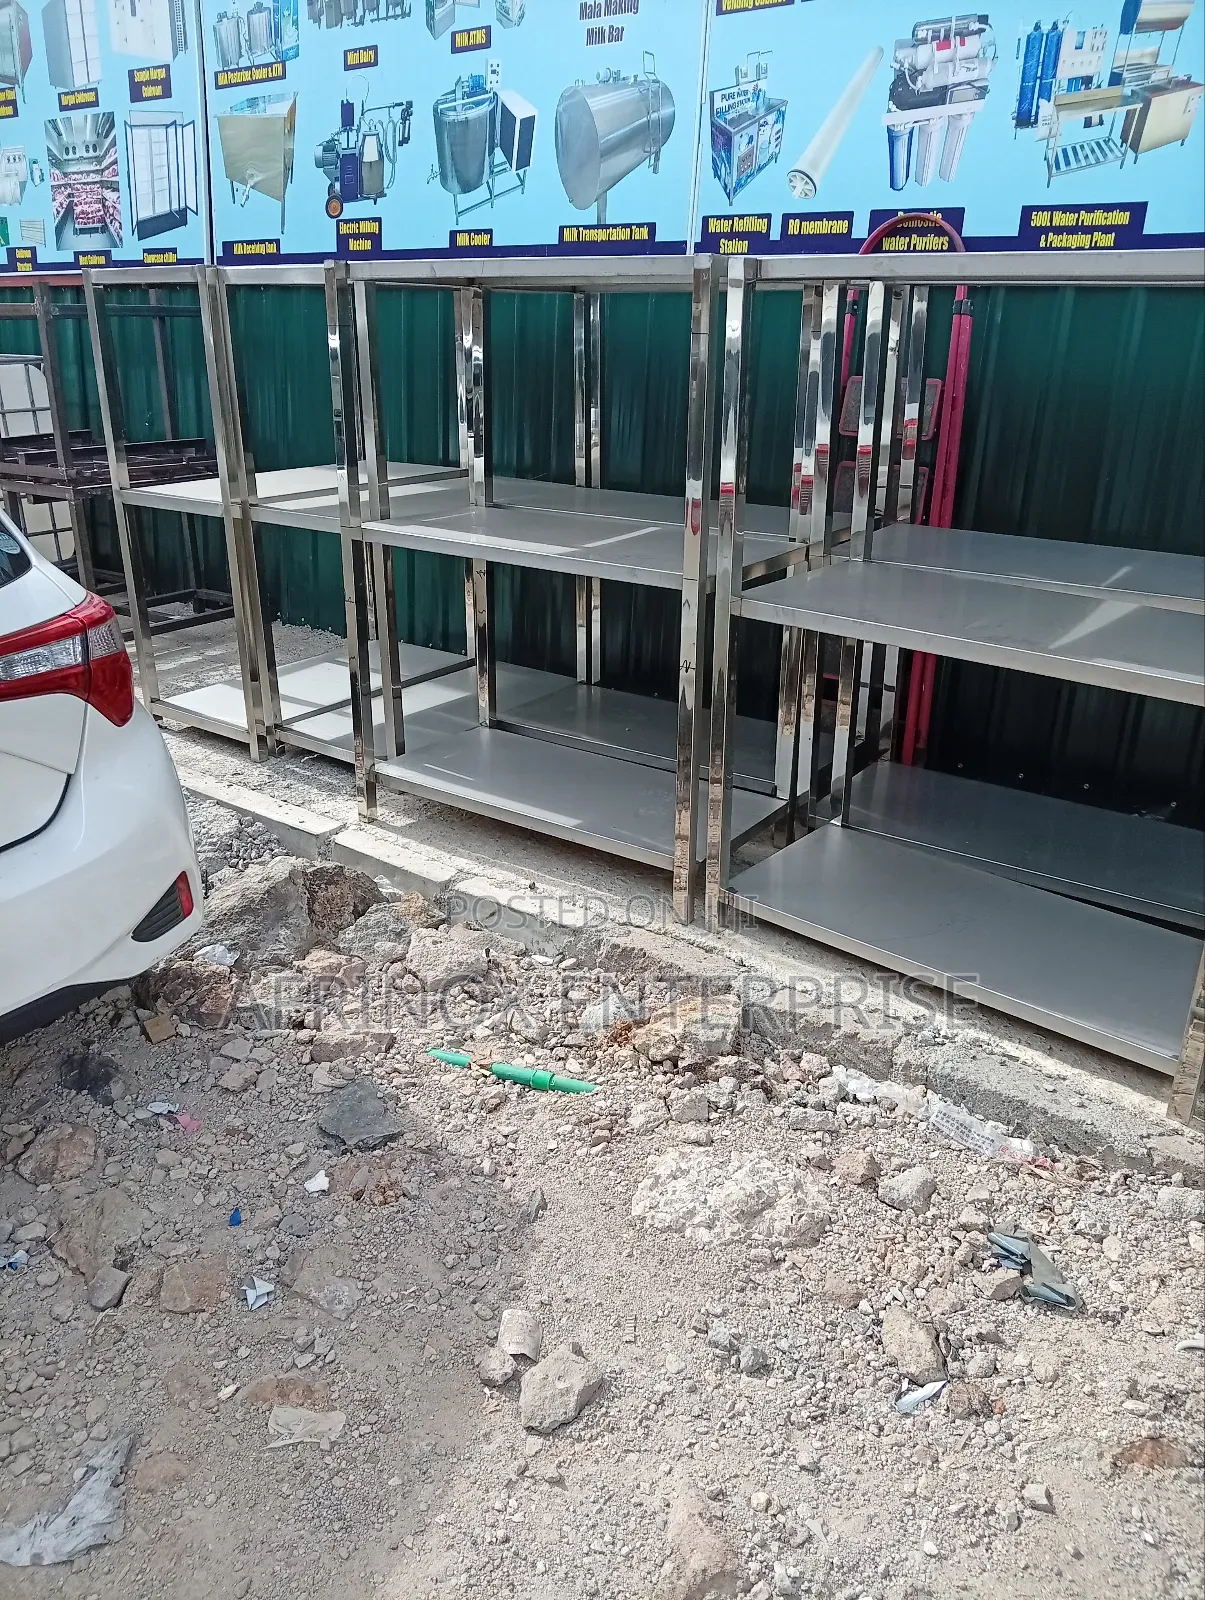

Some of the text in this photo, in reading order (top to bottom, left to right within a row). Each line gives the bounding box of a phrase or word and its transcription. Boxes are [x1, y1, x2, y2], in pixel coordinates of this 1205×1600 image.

[579, 0, 640, 21] Mala Making
[586, 24, 625, 47] Milk Bar
[359, 49, 375, 64] Dairy
[708, 216, 768, 233] Water Refilling
[1052, 210, 1078, 226] Water
[1078, 209, 1130, 226] Purification
[563, 224, 649, 243] Milk Transportation Tank
[788, 218, 848, 235] RO membrane
[348, 238, 373, 251] Machine
[456, 232, 491, 247] Milk Cooler
[719, 238, 749, 254] Station
[882, 235, 910, 251] water
[1039, 232, 1115, 249] & Packaging Plant
